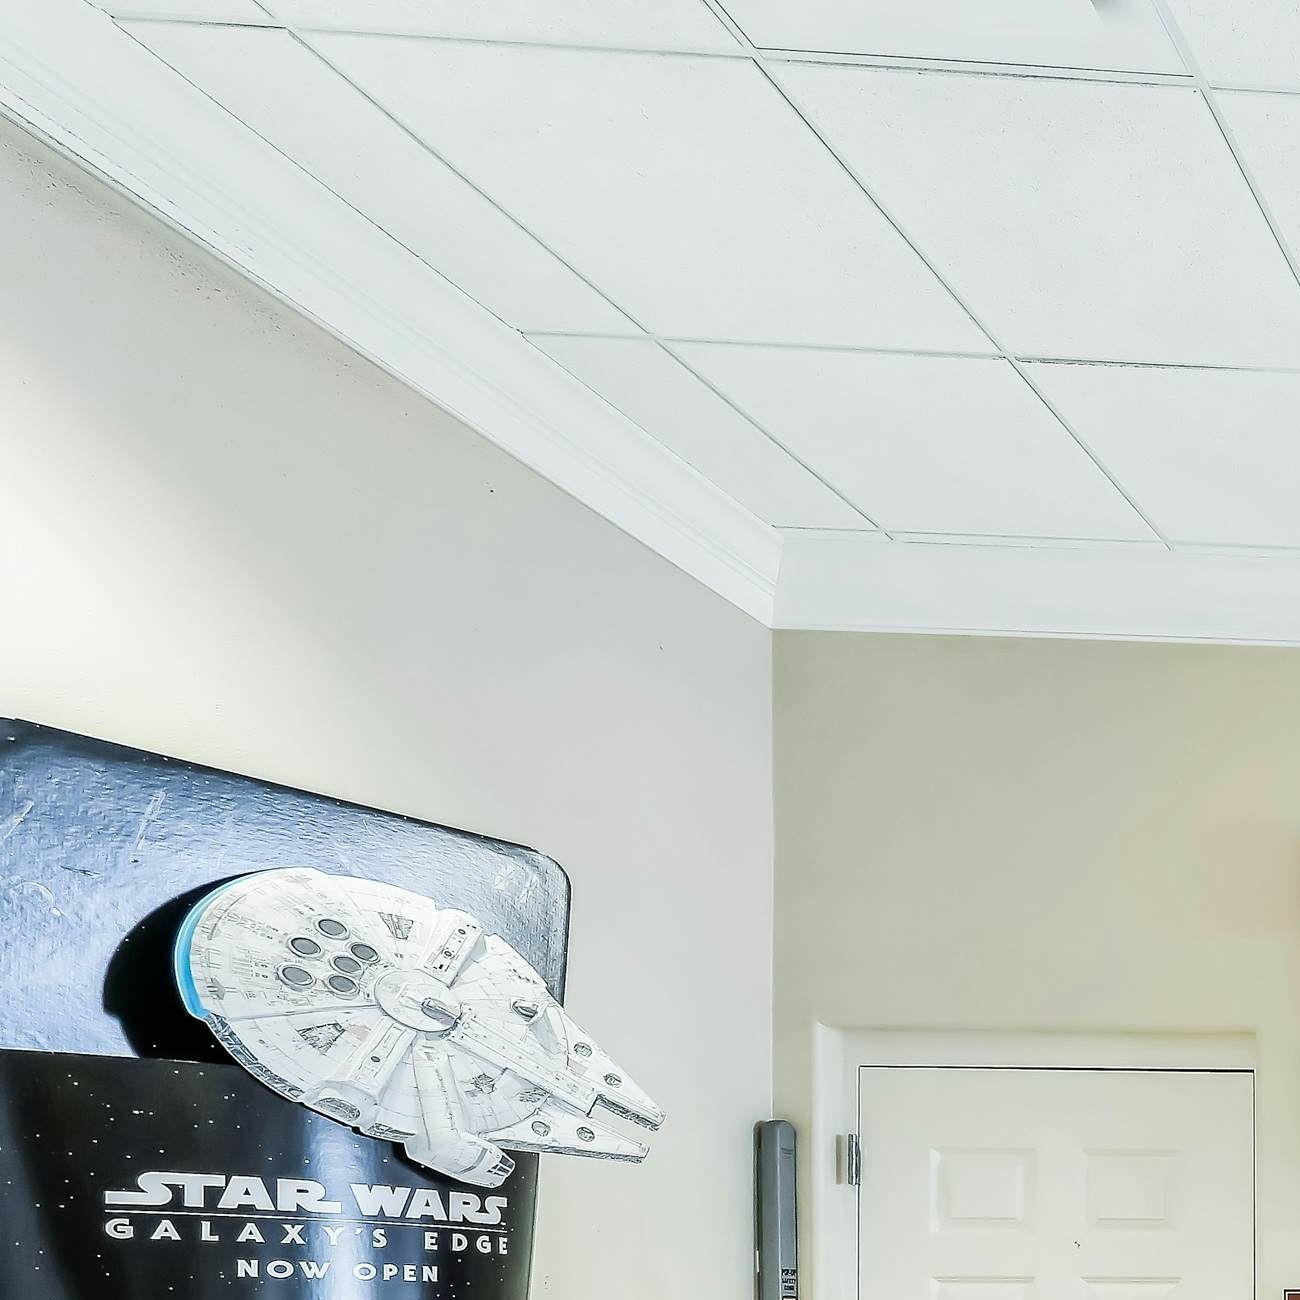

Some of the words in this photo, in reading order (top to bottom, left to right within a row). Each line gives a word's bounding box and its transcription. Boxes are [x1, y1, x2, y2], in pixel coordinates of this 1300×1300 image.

[105, 1171, 341, 1216] STAR
[350, 1185, 507, 1227] WARS
[105, 1218, 387, 1248] GALAXY'S
[425, 1227, 508, 1256] EDGE
[237, 1260, 331, 1280] NOW
[353, 1263, 439, 1283] OPEN
